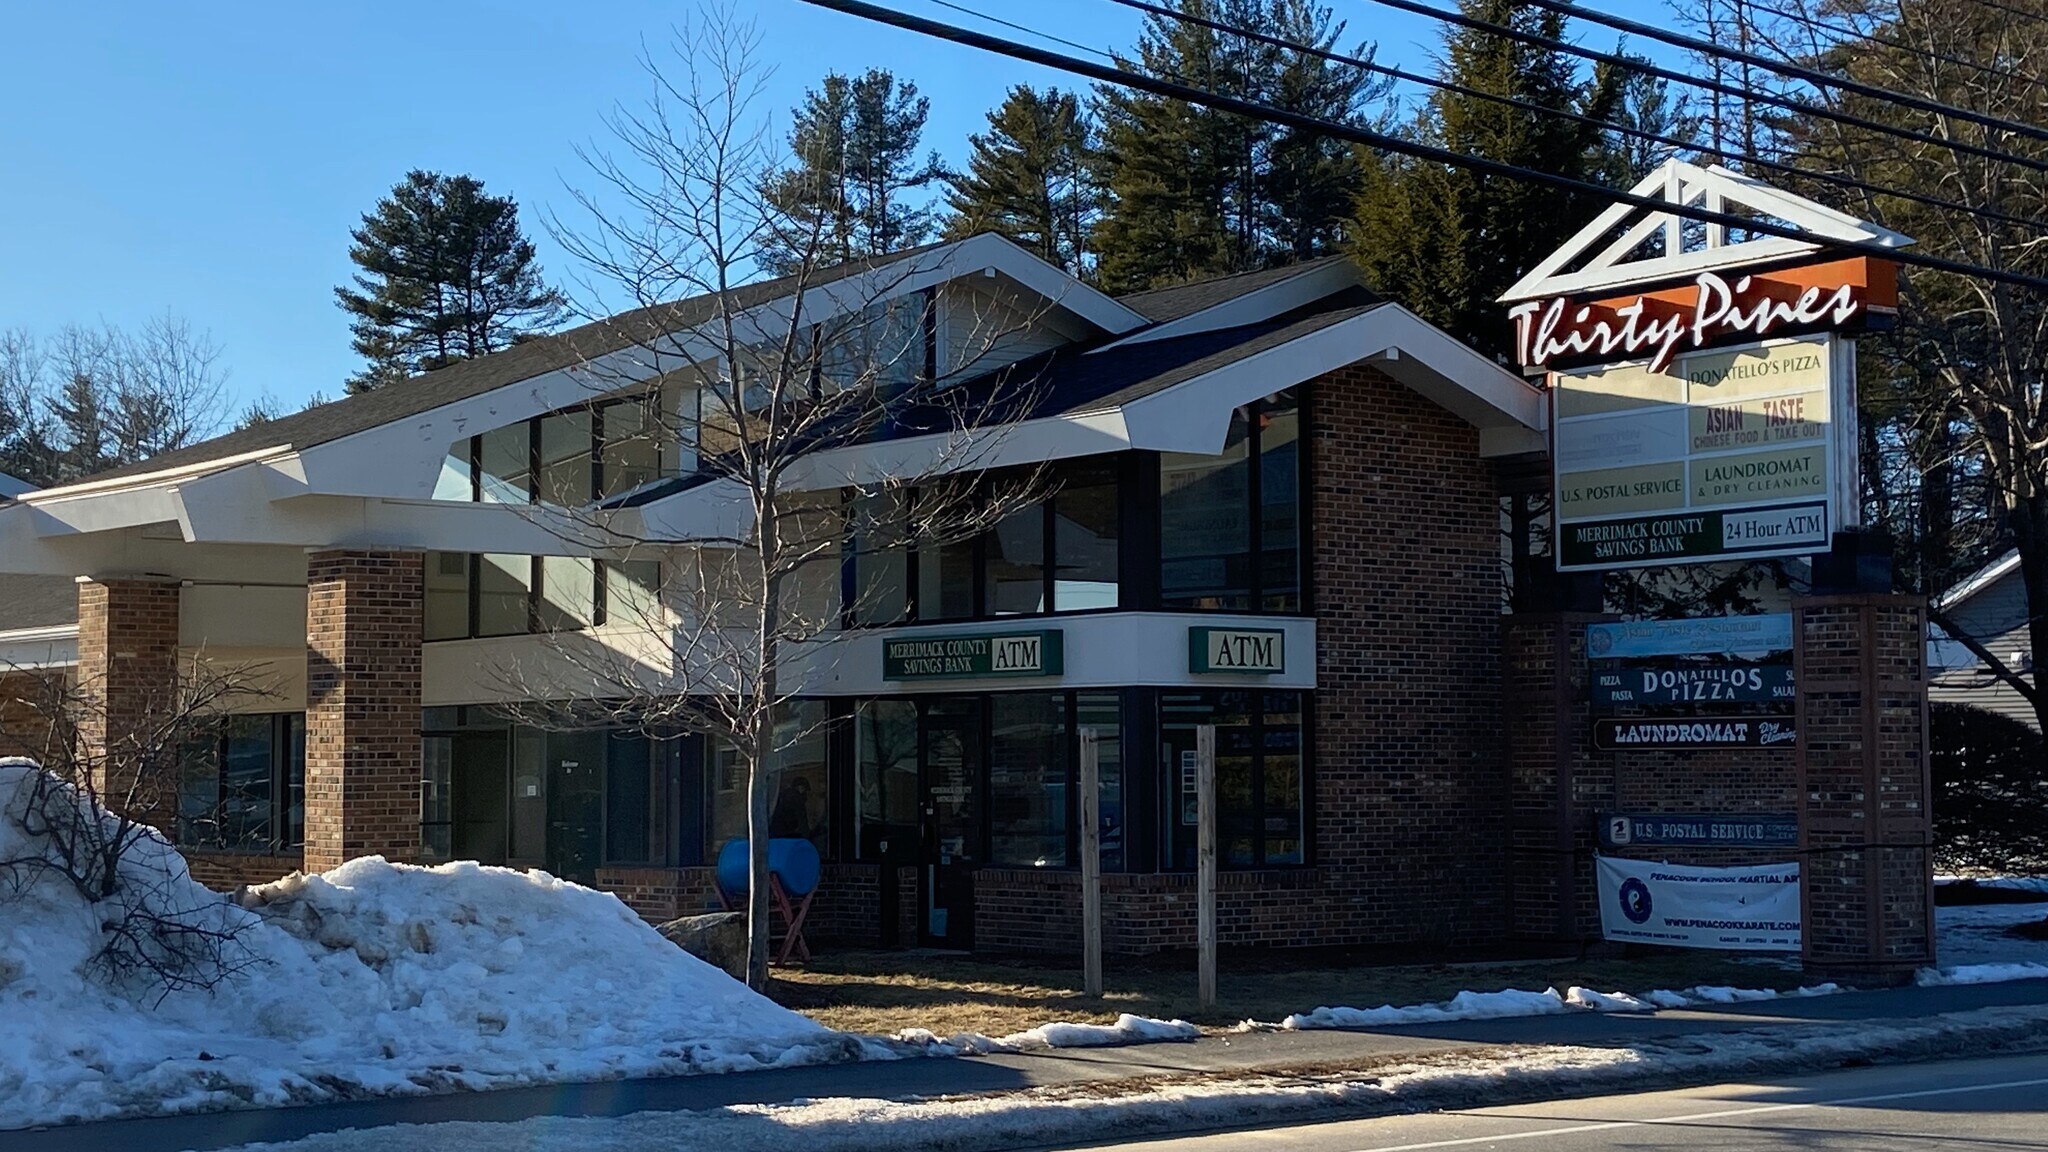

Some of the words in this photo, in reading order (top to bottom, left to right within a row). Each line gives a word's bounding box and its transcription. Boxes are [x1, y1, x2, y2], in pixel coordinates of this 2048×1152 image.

[1508, 297, 1684, 373] Thirty
[1693, 272, 1857, 346] Pines
[1690, 361, 1779, 385] DONATELLO'S
[1783, 355, 1821, 373] PIZZA
[1706, 405, 1743, 434] ASIAN
[1763, 397, 1804, 428] TASTE
[1694, 435, 1730, 449] CHINESE
[1735, 430, 1758, 444] FOOD
[1764, 430, 1769, 441] &
[1775, 425, 1798, 439] TAKE
[1803, 423, 1821, 437] OUT
[1705, 457, 1811, 482] LAUNDROMAT
[1562, 489, 1582, 502] U.S.
[1587, 484, 1631, 500] POSTAL
[1633, 479, 1681, 495] SERVICE
[1698, 487, 1705, 496] &
[1714, 483, 1739, 495] DRY
[1748, 475, 1820, 491] CLEANING
[1576, 523, 1648, 542] MERRIMACK
[1652, 518, 1704, 536] COUNTY
[1726, 523, 1741, 540] 24
[1745, 519, 1782, 538] Hour
[1785, 515, 1821, 535] ATM
[1594, 539, 1645, 557] SAVINGS
[1650, 537, 1684, 552] BANK
[889, 641, 945, 659] MERRIMACK
[946, 640, 989, 656] COUNTY
[995, 640, 1038, 668] ATM
[1215, 635, 1276, 668] ATM
[903, 658, 942, 675] SAVINGS
[945, 657, 972, 672] BANK
[1600, 675, 1621, 686] PIZZA
[1611, 690, 1633, 701] PASTA
[1672, 681, 1735, 701] PIZZA
[1615, 723, 1748, 743] LAUNDROMAT
[1758, 721, 1780, 734] Dry
[1760, 728, 1797, 745] Cleaning
[1635, 824, 1656, 838] U.S.
[1662, 823, 1706, 839] POSTAL
[1710, 824, 1764, 840] SERVICE
[1738, 875, 1782, 884] MARTIAL
